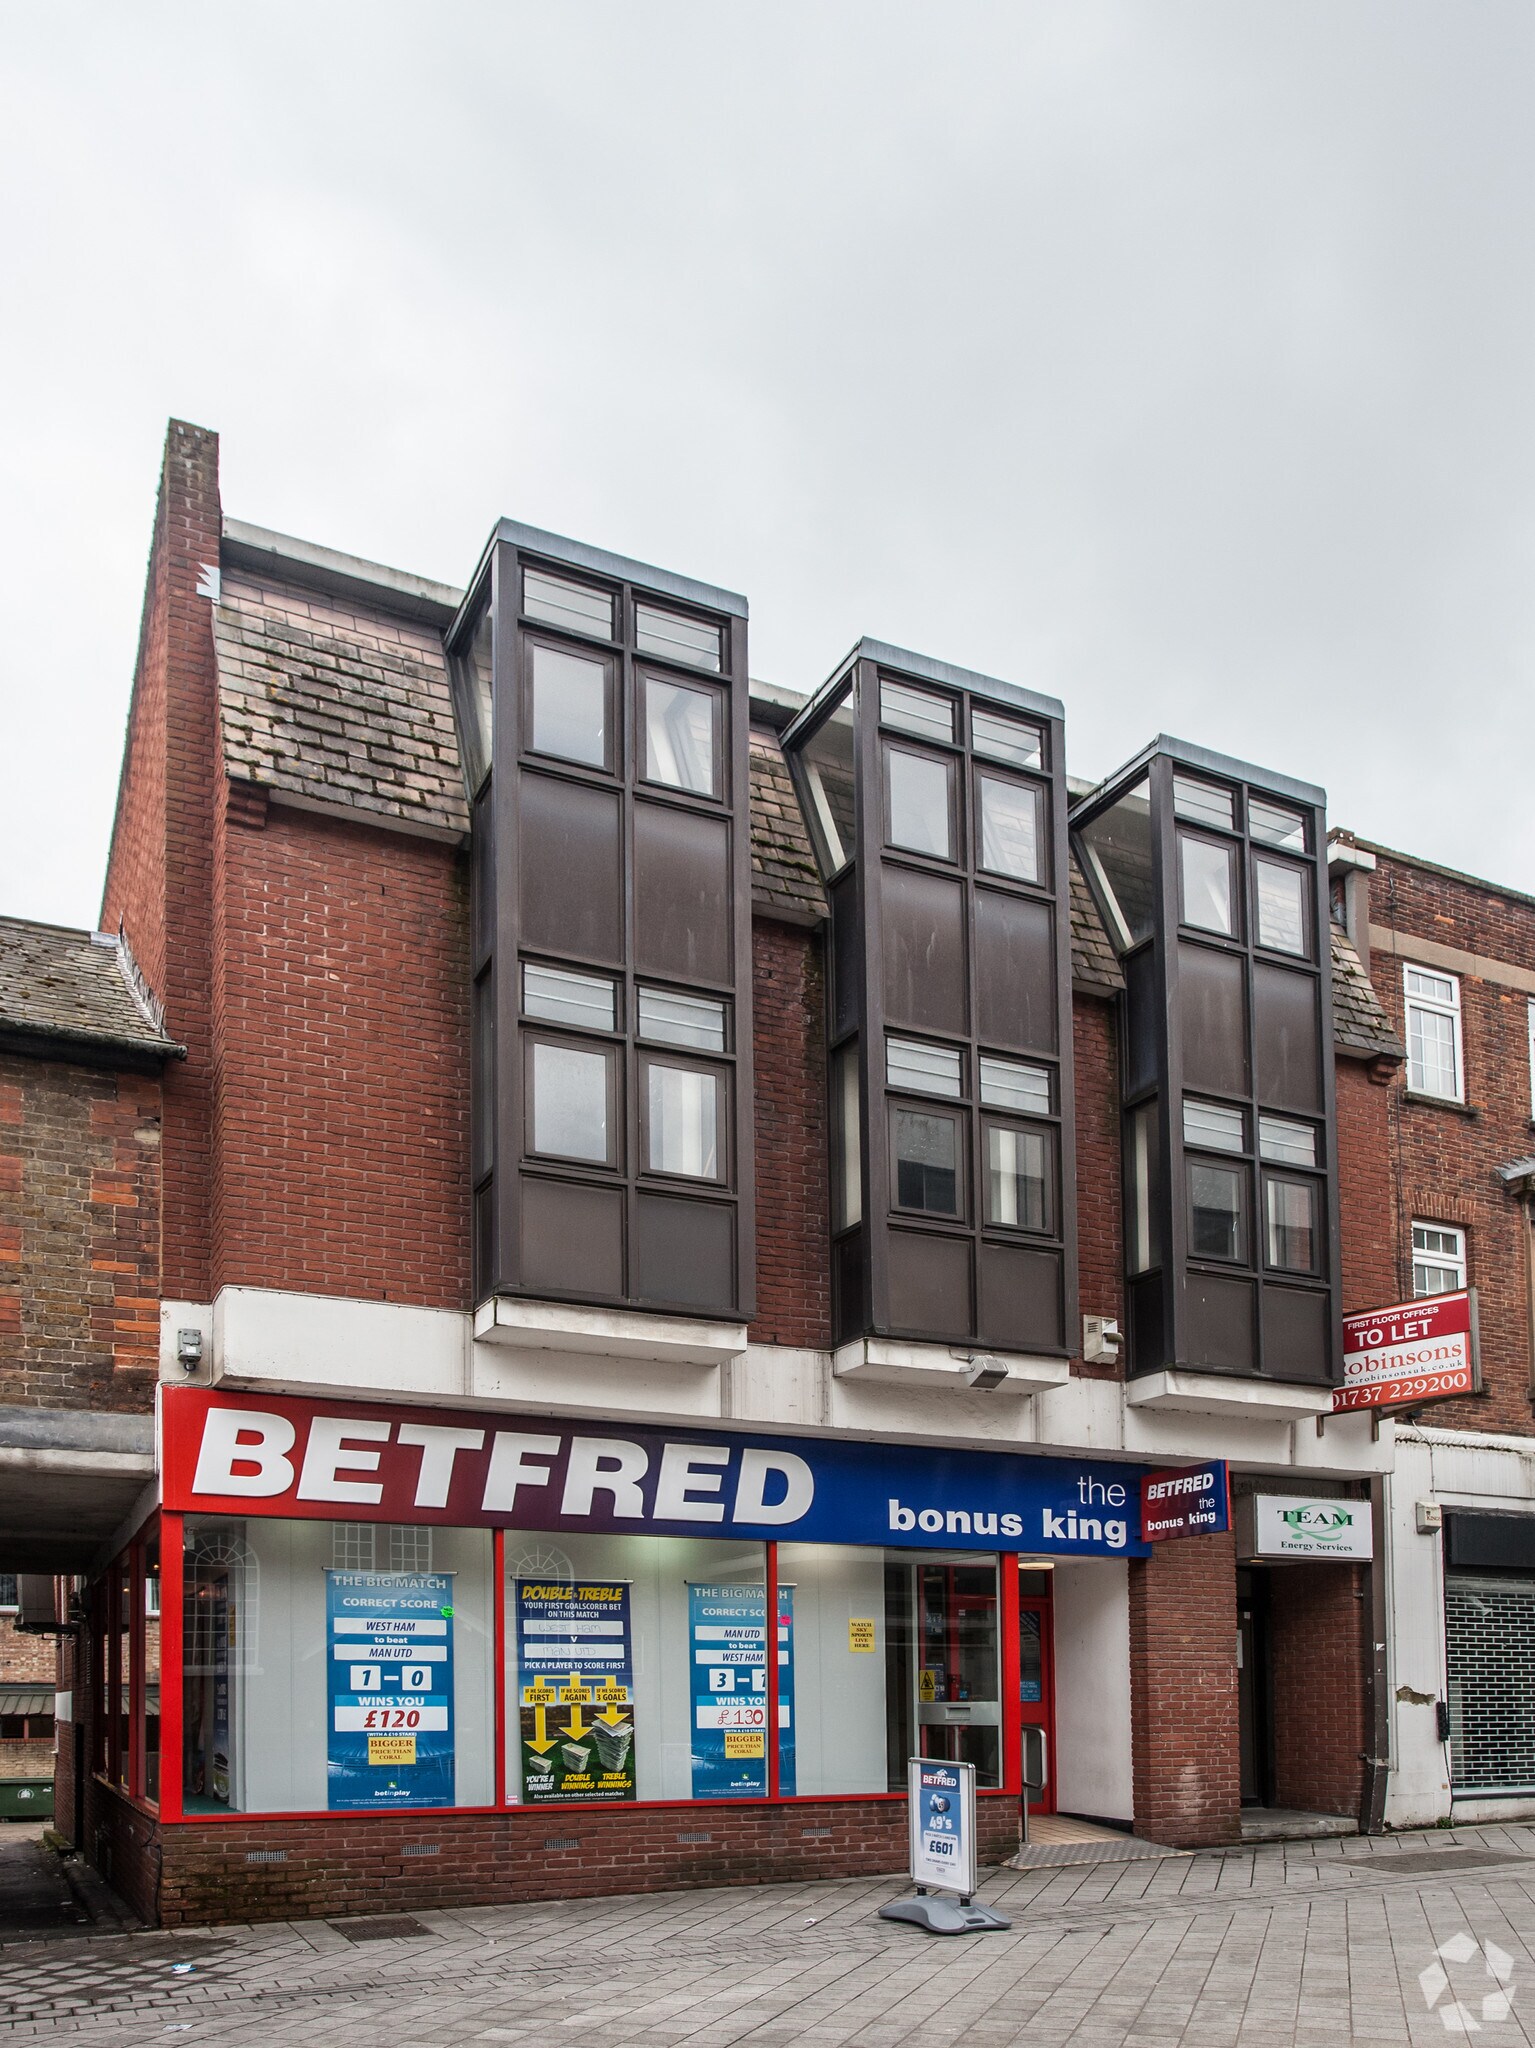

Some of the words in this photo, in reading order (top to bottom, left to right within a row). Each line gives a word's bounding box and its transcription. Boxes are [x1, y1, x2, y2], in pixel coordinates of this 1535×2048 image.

[1347, 1320, 1370, 1330] FIRST
[1372, 1314, 1400, 1325] FLOOR
[1402, 1306, 1440, 1318] OFFICES
[1354, 1328, 1384, 1347] TO
[1391, 1318, 1433, 1342] LET
[1344, 1343, 1463, 1377] obinsons
[1347, 1360, 1463, 1385] w.robinsonsuk.co.uk
[1389, 1372, 1467, 1399] 229200
[191, 1407, 815, 1526] BETFRED
[1077, 1475, 1126, 1507] the
[1147, 1472, 1214, 1500] BETFRED
[1198, 1497, 1216, 1510] the
[888, 1498, 1023, 1537] bonus
[1042, 1508, 1127, 1548] king
[1147, 1517, 1184, 1532] bonus
[1188, 1511, 1216, 1525] king
[1277, 1509, 1354, 1526] TEAM
[1281, 1540, 1315, 1551] Energy
[1315, 1542, 1353, 1552] Services
[333, 1575, 363, 1587] THE
[366, 1576, 392, 1588] BIG
[395, 1578, 447, 1589] MATCH
[521, 1585, 573, 1600] DOUBLE
[577, 1587, 623, 1601] TREBLE
[694, 1588, 718, 1598] THE
[721, 1588, 743, 1598] BIG
[745, 1589, 788, 1600] MAH
[342, 1597, 398, 1608] CORRECT
[400, 1599, 438, 1609] SCORE
[564, 1602, 608, 1610] GOALSCORER
[702, 1607, 748, 1616] CORRECT
[366, 1621, 392, 1631] WEST
[393, 1622, 416, 1632] HAM
[374, 1636, 385, 1644] to
[386, 1636, 408, 1644] beat
[723, 1629, 744, 1638] MAN
[744, 1630, 760, 1638] UTD
[368, 1648, 392, 1658] MAN
[393, 1648, 413, 1658] UTD
[722, 1653, 744, 1662] WEST
[744, 1653, 763, 1662] HAM
[362, 1669, 371, 1687] 1
[411, 1670, 424, 1687] 0
[717, 1672, 727, 1688] 3
[358, 1696, 394, 1706] WINS
[396, 1696, 425, 1706] YOU
[715, 1697, 746, 1706] WINS
[747, 1697, 766, 1706] YO
[363, 1710, 421, 1728] £120
[717, 1709, 764, 1725] £130
[370, 1739, 413, 1747] BIGGER
[565, 1774, 591, 1782] DOUBLE
[602, 1772, 626, 1780] TREBLE
[922, 1774, 957, 1787] BETFRED
[528, 1783, 553, 1791] WINNER
[561, 1781, 595, 1790] WINNINGS
[597, 1780, 632, 1789] WINNINGS
[929, 1815, 952, 1830] 49's
[929, 1840, 953, 1856] £601
